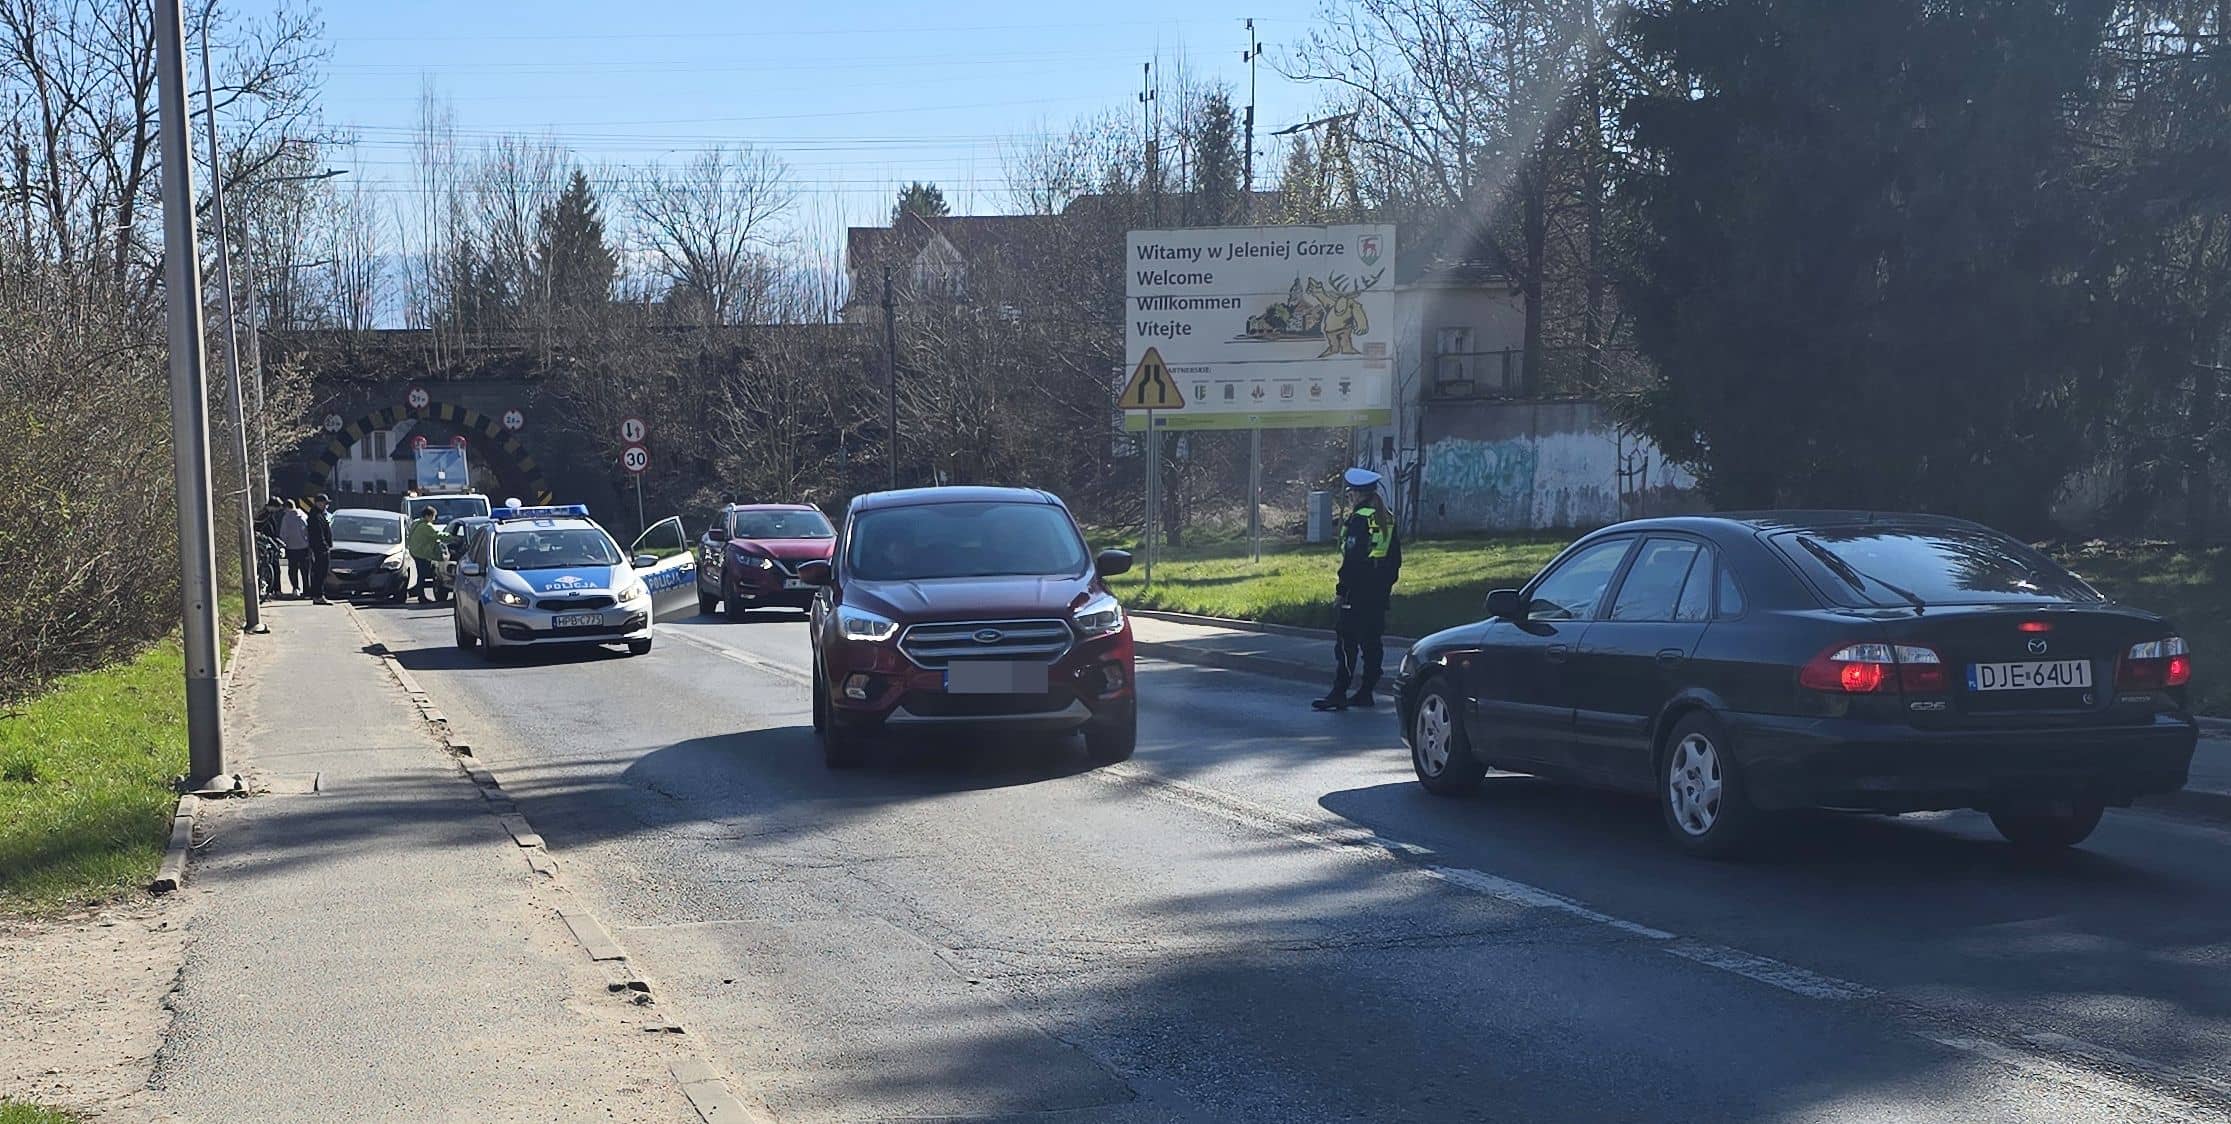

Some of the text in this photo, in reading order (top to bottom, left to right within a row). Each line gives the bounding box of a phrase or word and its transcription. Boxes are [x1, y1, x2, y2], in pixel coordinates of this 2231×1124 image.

[1137, 239, 1344, 263] Witamy w Jeleniej Górze
[1137, 269, 1213, 286] Welcome
[1136, 296, 1241, 311] Willkommen
[1136, 320, 1192, 340] Vítejte
[1167, 366, 1212, 374] ARTNERSKIE:
[627, 452, 646, 466] 30
[649, 574, 681, 589] POLICJA
[1981, 662, 2084, 688] DJE 64U1
[1910, 701, 1947, 711] 626
